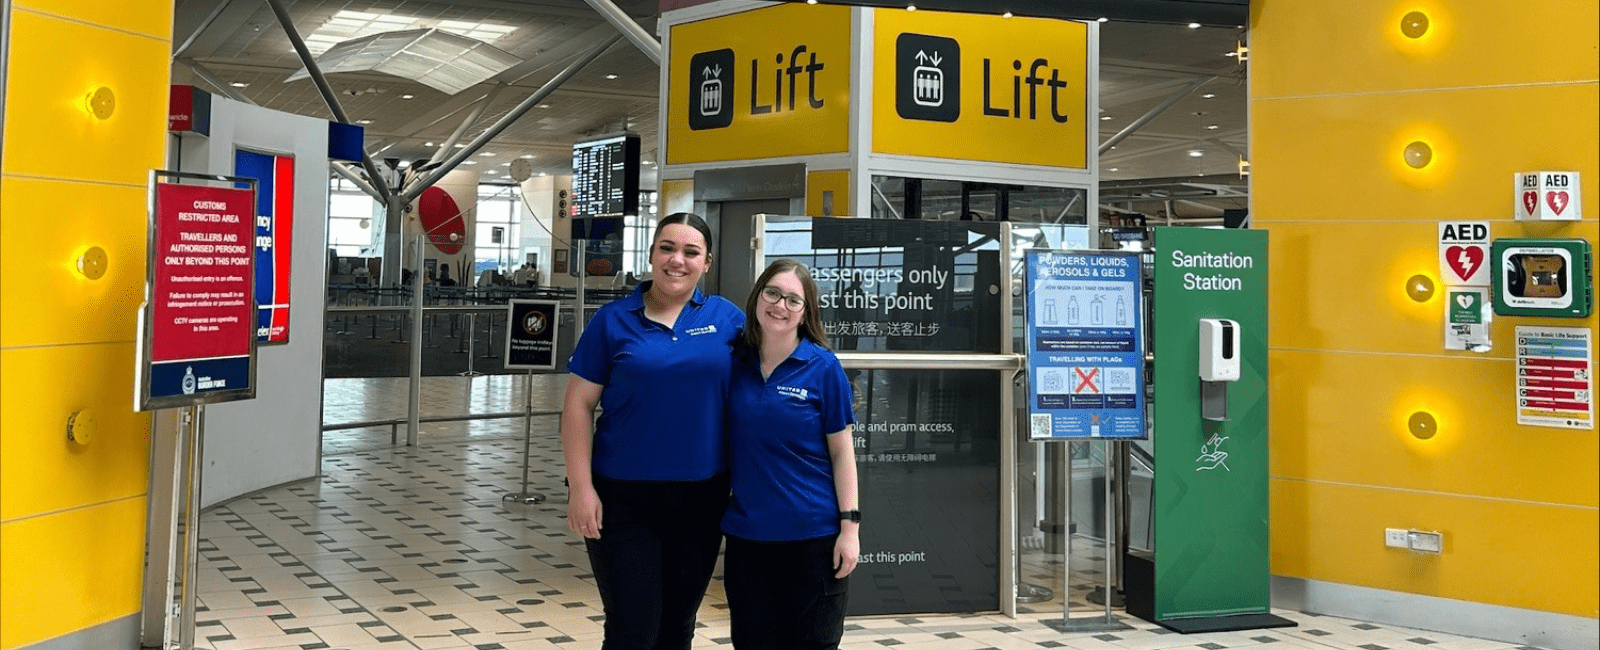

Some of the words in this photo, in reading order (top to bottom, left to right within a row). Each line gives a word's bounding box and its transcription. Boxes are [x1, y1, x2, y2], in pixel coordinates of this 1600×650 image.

[750, 45, 824, 115] Lift
[983, 58, 1068, 123] Lift
[1523, 174, 1537, 187] AED
[1545, 174, 1569, 187] AED
[193, 200, 226, 211] CUSTOMS
[178, 212, 220, 222] RESTRICTED
[222, 214, 240, 223] AREA
[180, 232, 222, 242] TRAVELLERS
[223, 233, 238, 242] AND
[1442, 224, 1487, 240] AED
[170, 244, 213, 253] AUTHORISED
[215, 245, 246, 254] PERSONS
[165, 257, 184, 265] ONLY
[185, 257, 213, 265] BEYOND
[215, 257, 230, 265] THIS
[231, 257, 249, 265] POINT
[1090, 257, 1130, 267] LIQUIDS,
[1172, 250, 1253, 268] Sanitation
[809, 266, 904, 288] assengers
[908, 264, 948, 290] only
[1092, 268, 1099, 277] &
[1100, 268, 1126, 277] GELS
[1183, 272, 1242, 290] Station
[818, 291, 839, 309] st
[843, 289, 879, 309] this
[885, 292, 933, 315] point
[174, 317, 189, 325] CCTV
[257, 325, 270, 336] elex
[821, 321, 940, 336] 出发旅客，送客止步
[1519, 347, 1526, 355] R
[1520, 368, 1527, 376] A
[776, 385, 801, 393] UNITED
[1521, 399, 1528, 407] D
[867, 420, 888, 432] and
[889, 423, 917, 434] pram
[918, 423, 955, 433] access,
[854, 436, 866, 448] ift
[858, 552, 874, 564] ast
[876, 551, 896, 563] this
[898, 551, 926, 565] point
